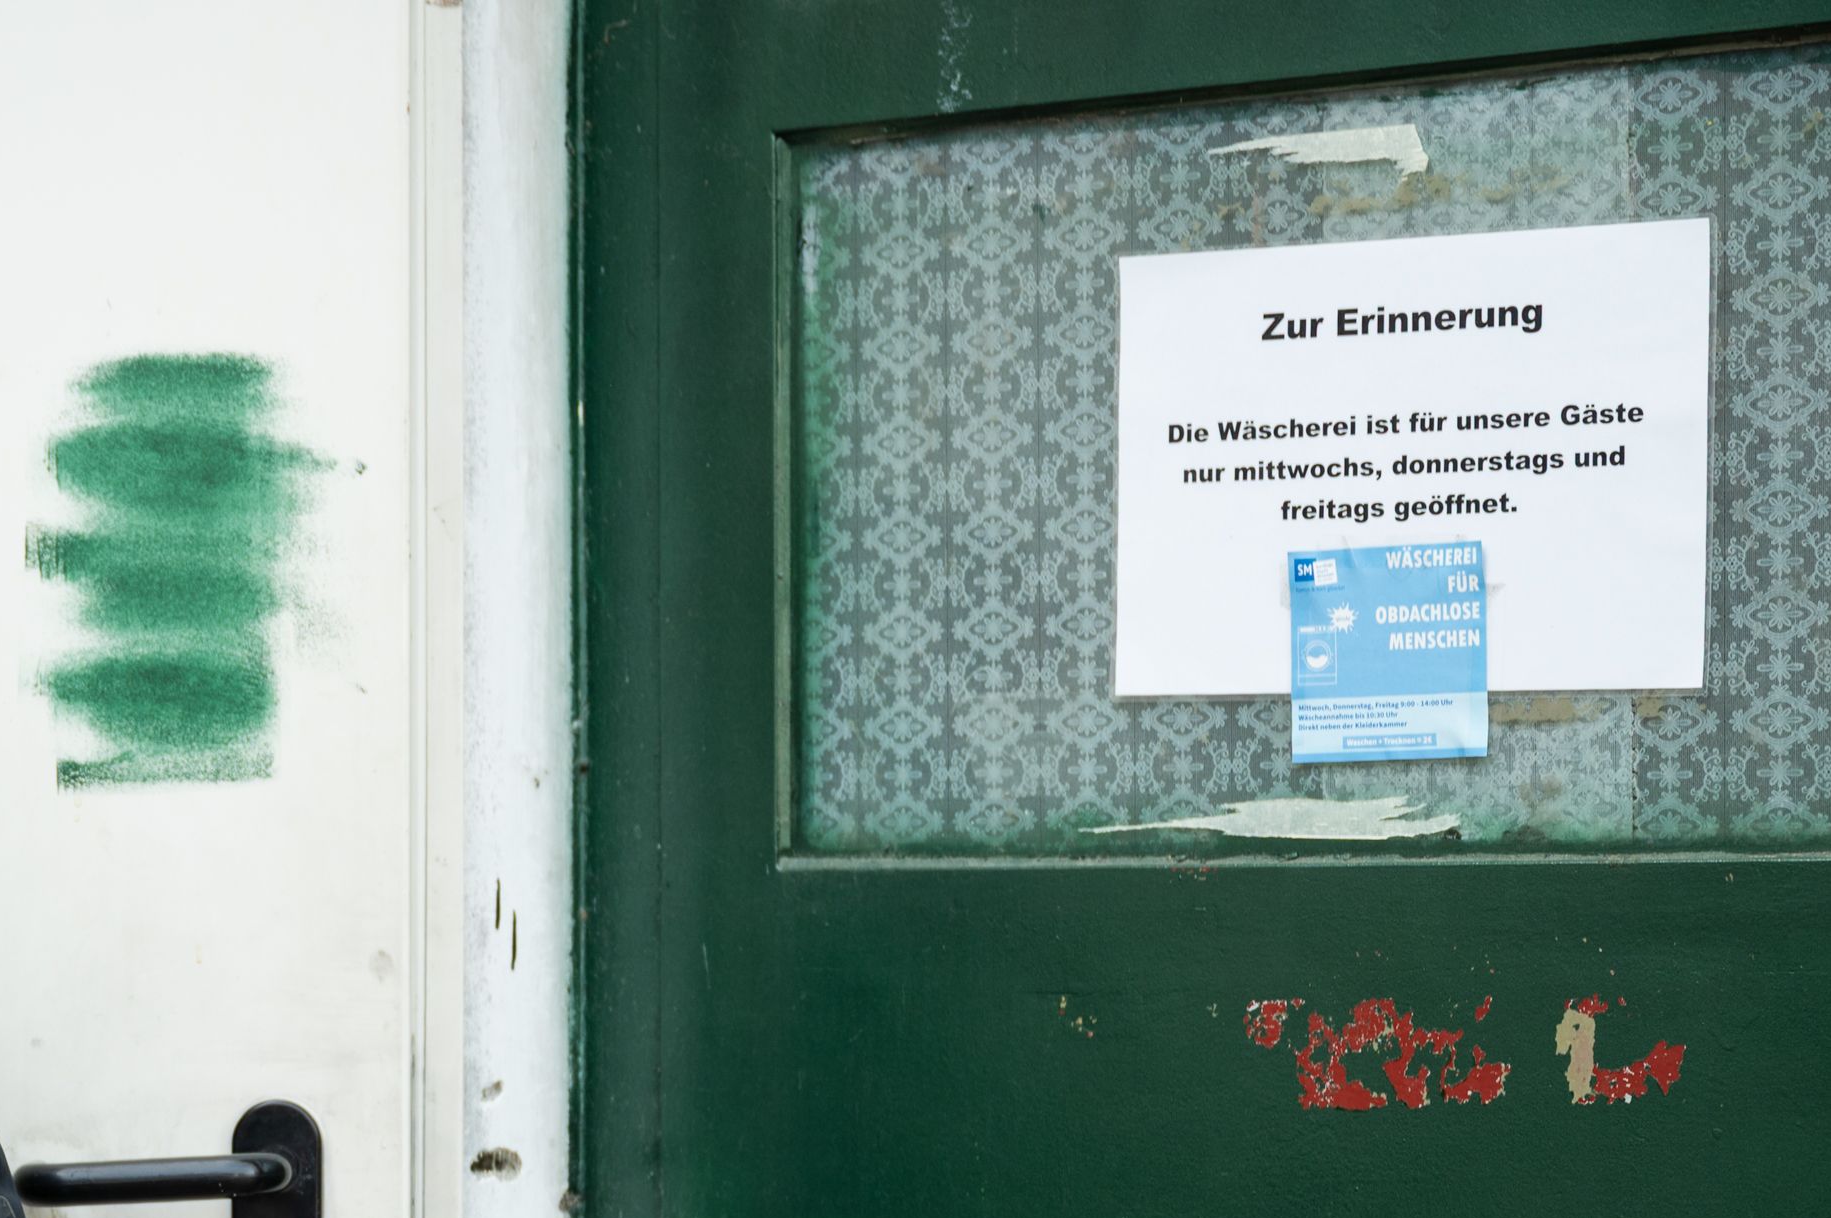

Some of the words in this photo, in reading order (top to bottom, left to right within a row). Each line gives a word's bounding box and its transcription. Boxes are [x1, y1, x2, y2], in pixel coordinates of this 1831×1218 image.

[1262, 312, 1324, 341] Zur
[1336, 304, 1543, 335] Erinnerung
[1168, 423, 1209, 444] Die
[1218, 415, 1356, 441] Wäscherei
[1366, 413, 1400, 435] ist
[1409, 412, 1448, 433] für
[1456, 410, 1551, 431] unsere
[1560, 403, 1644, 427] Gäste
[1183, 465, 1226, 484] nur
[1233, 456, 1383, 482] mittwochs,
[1392, 450, 1565, 475] donnerstags
[1574, 445, 1626, 468] und
[1281, 499, 1385, 523] freitags
[1394, 492, 1518, 522] geöffnet.
[1385, 546, 1477, 570] WÄSCHEREI
[1297, 563, 1313, 577] SM
[1447, 570, 1480, 593] FÜR
[1375, 601, 1481, 625] OBDACHLOSE
[1389, 628, 1481, 651] MENSCHEN
[1355, 712, 1365, 720] bis
[1385, 711, 1398, 719] Uhr
[1375, 701, 1399, 710] Freitag
[1400, 700, 1416, 708] 9:00
[1420, 699, 1440, 707] 14:00
[1440, 698, 1453, 706] Uhr
[1298, 723, 1319, 731] Direkt
[1320, 722, 1341, 730] neben
[1342, 722, 1353, 730] der
[1355, 720, 1408, 729] Kleiderkammer
